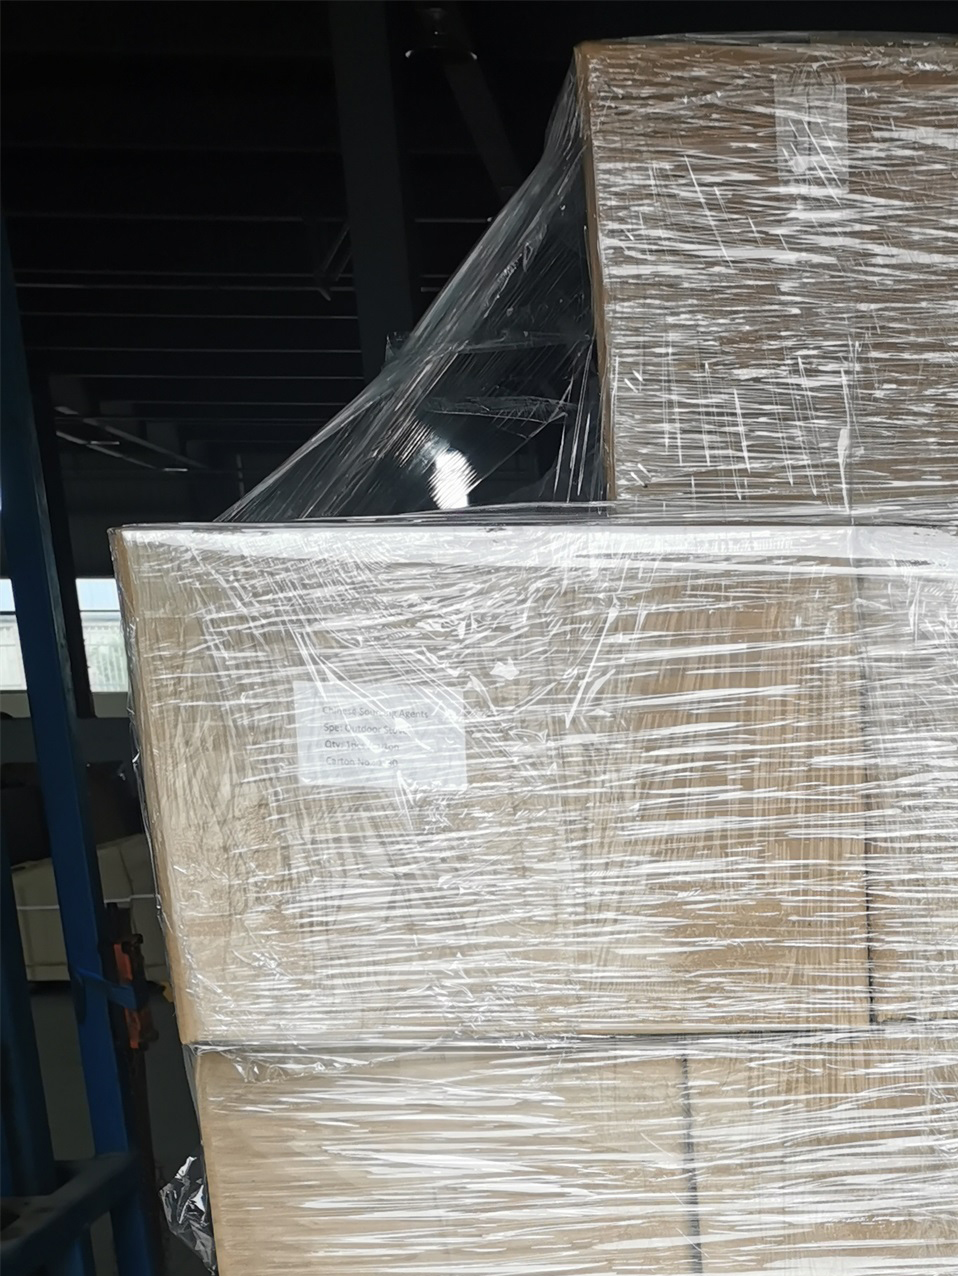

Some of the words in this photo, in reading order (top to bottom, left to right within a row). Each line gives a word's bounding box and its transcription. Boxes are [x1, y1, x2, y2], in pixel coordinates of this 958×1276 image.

[399, 708, 429, 720] Agents
[324, 722, 343, 733] Spe:
[345, 724, 382, 734] Outdoor
